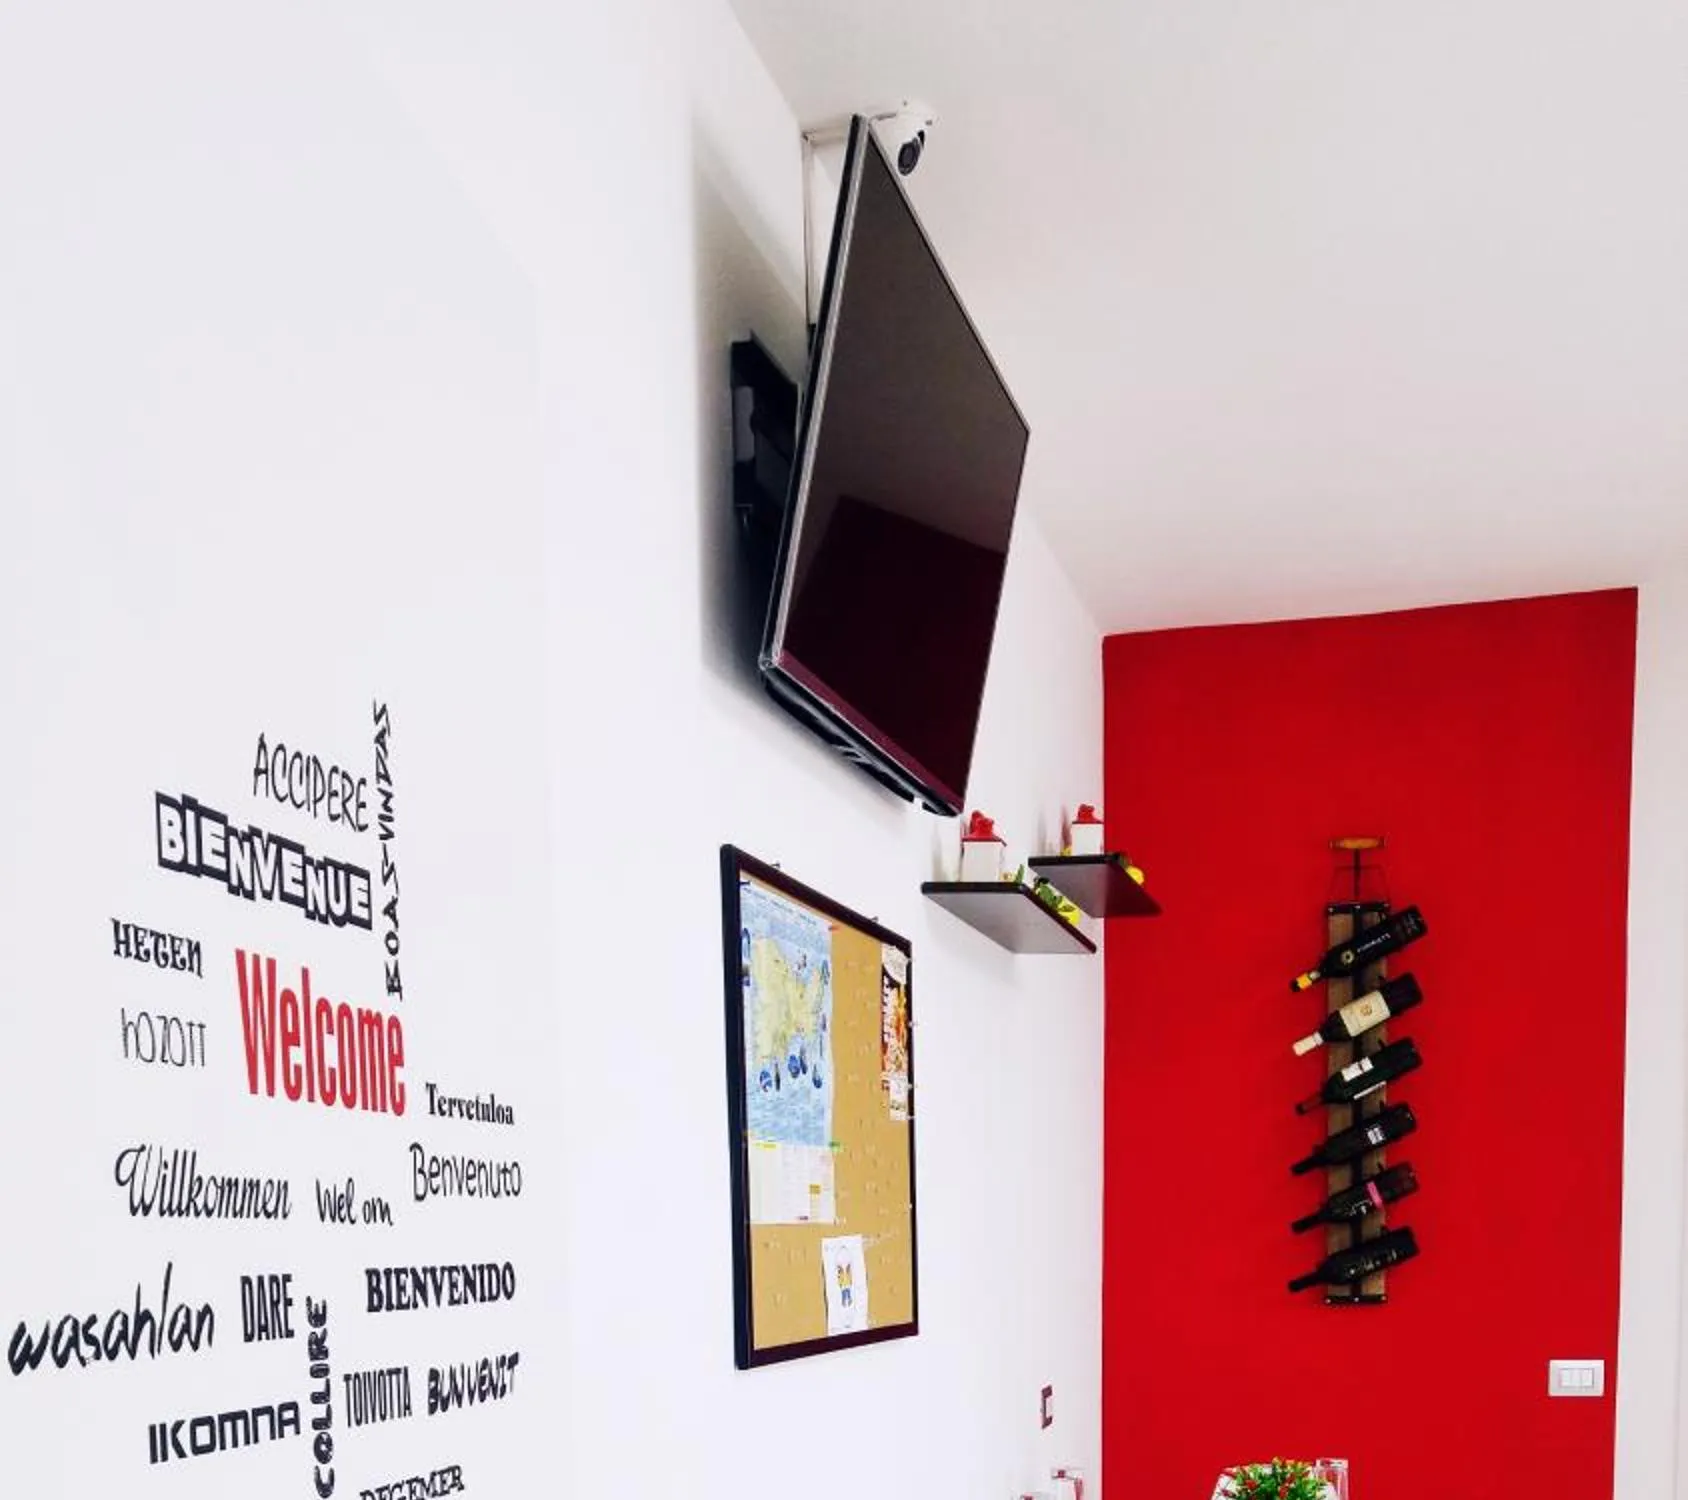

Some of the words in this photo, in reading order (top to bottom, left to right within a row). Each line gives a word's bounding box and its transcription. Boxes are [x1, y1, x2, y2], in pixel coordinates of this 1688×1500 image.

[253, 732, 369, 833] ACCIPERE
[154, 790, 373, 932] BIENVENUE
[111, 917, 203, 979] HETEN
[234, 948, 406, 1117] Welcome
[425, 1081, 515, 1126] Tervetuloa
[114, 1143, 291, 1220] Willkommen
[408, 1141, 522, 1203] Benvenuto
[7, 1261, 215, 1377] wasahlan
[239, 1273, 295, 1343] DARE
[364, 1261, 516, 1313] BIENVENIDO
[342, 1365, 413, 1429] TOIVOTTA
